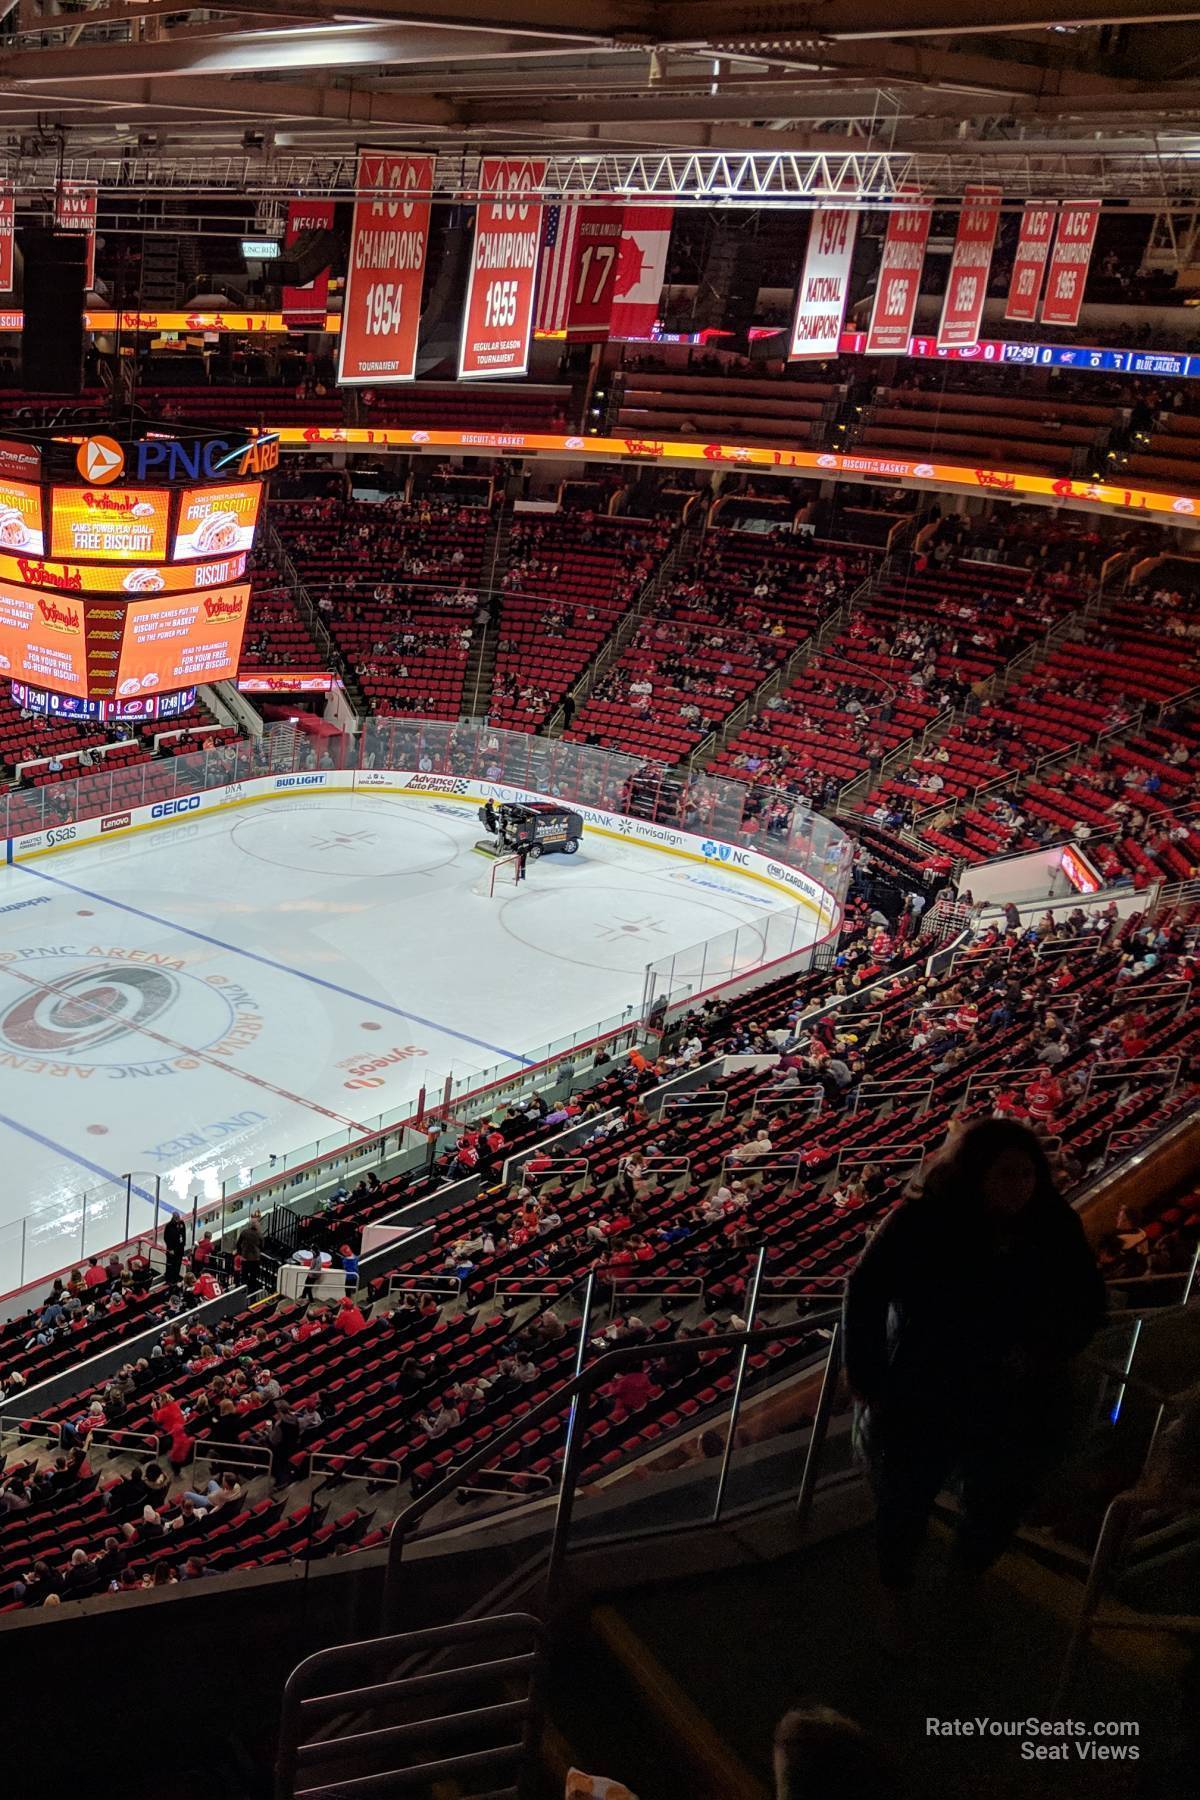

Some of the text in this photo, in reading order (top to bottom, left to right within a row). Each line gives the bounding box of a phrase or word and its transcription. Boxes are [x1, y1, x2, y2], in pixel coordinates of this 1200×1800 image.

[372, 146, 418, 218] ACC
[491, 151, 531, 220] ACC
[818, 206, 850, 256] 1974
[1026, 211, 1049, 236] ACC
[1064, 211, 1091, 236] ACC
[356, 231, 424, 270] CHAMPIONS
[477, 232, 537, 269] CHAMPIONS
[575, 245, 616, 304] 17
[805, 277, 842, 303] NATIONAL
[365, 283, 402, 335] 1954
[485, 281, 519, 327] 1955
[797, 314, 839, 342] CHAMPIONS
[477, 353, 516, 364] TOURNAMENT
[984, 344, 994, 358] 0
[1006, 346, 1034, 357] 17:49
[1042, 349, 1052, 363] 0
[358, 361, 400, 372] TOURNAMENT
[1090, 357, 1100, 367] 0
[1136, 359, 1180, 373] BLUE JACKETS
[461, 434, 525, 446] BISCUIT BASKET
[134, 440, 230, 480] PNC
[842, 459, 909, 474] BISCUIT BASKET
[187, 504, 211, 521] FREE
[212, 496, 257, 514] BISCUIT!
[92, 524, 131, 534] POWER PLAY
[75, 534, 153, 551] FREE BISCUIT!
[194, 562, 230, 587] BISCUIT
[133, 622, 159, 634] BISCUIT
[172, 616, 196, 627] BASKET
[176, 628, 189, 637] PLAY
[28, 652, 73, 672] FOR YOUR FREE
[182, 649, 227, 665] FOR YOUR FREE
[173, 663, 205, 676] BO-BERRY
[51, 696, 59, 709] 0
[146, 699, 154, 713] 0
[276, 774, 325, 788] BUD LIGHT
[404, 782, 452, 793] Auto Parts
[410, 774, 454, 786] Advance
[224, 784, 242, 795] DNA
[479, 783, 511, 802] UNC
[151, 796, 201, 819] GEICO
[102, 816, 130, 829] Lenovo
[636, 822, 684, 846] invisalign
[732, 850, 751, 867] NC
[784, 872, 817, 898] CAROLINAS
[17, 944, 187, 970] PNC ARENA
[208, 984, 265, 1058] PNC ARENA
[347, 1044, 430, 1077] Syneos
[108, 1063, 177, 1080] PNC
[141, 1110, 268, 1162] UNC REX
